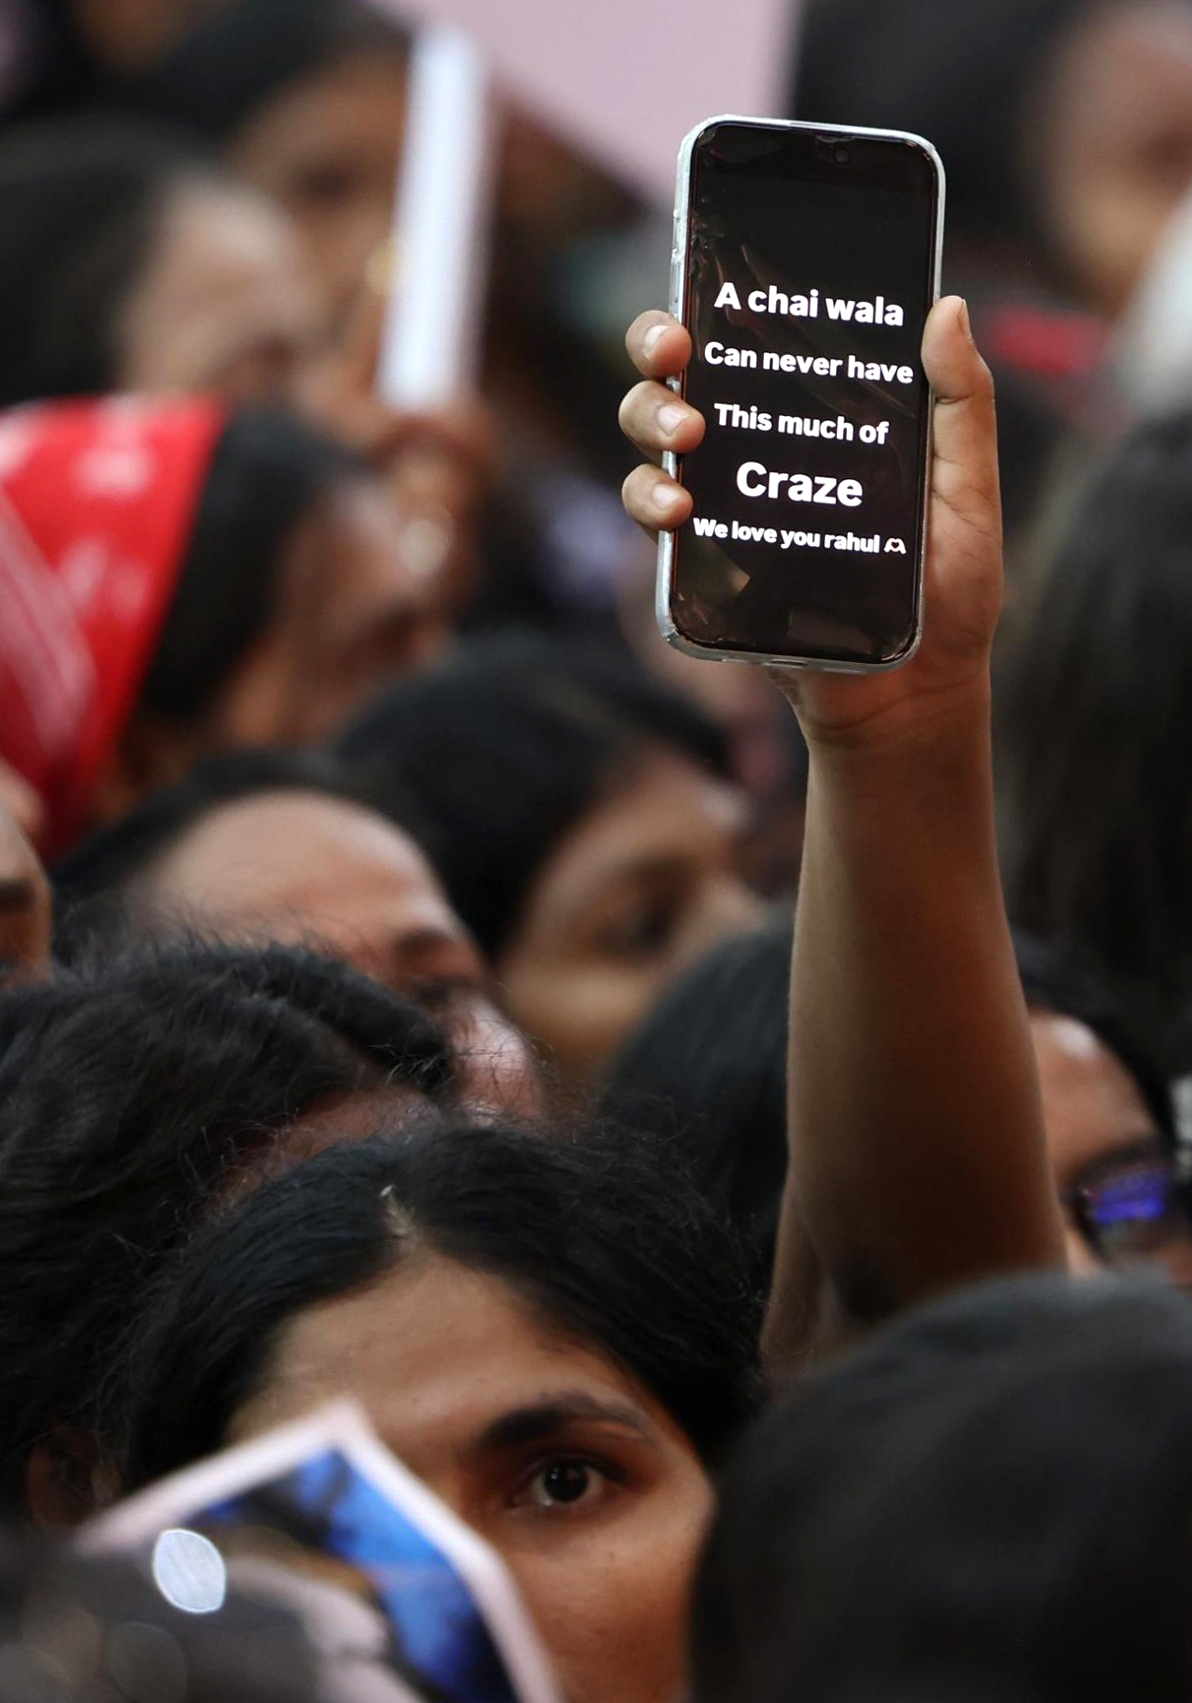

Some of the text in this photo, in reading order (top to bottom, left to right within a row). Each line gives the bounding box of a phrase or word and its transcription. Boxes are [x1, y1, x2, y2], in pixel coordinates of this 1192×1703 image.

[714, 282, 903, 326] A chai wala
[705, 342, 914, 383] Can never have
[714, 403, 889, 444] This much of
[736, 462, 863, 506] Craze
[693, 518, 880, 553] We love you rahul
